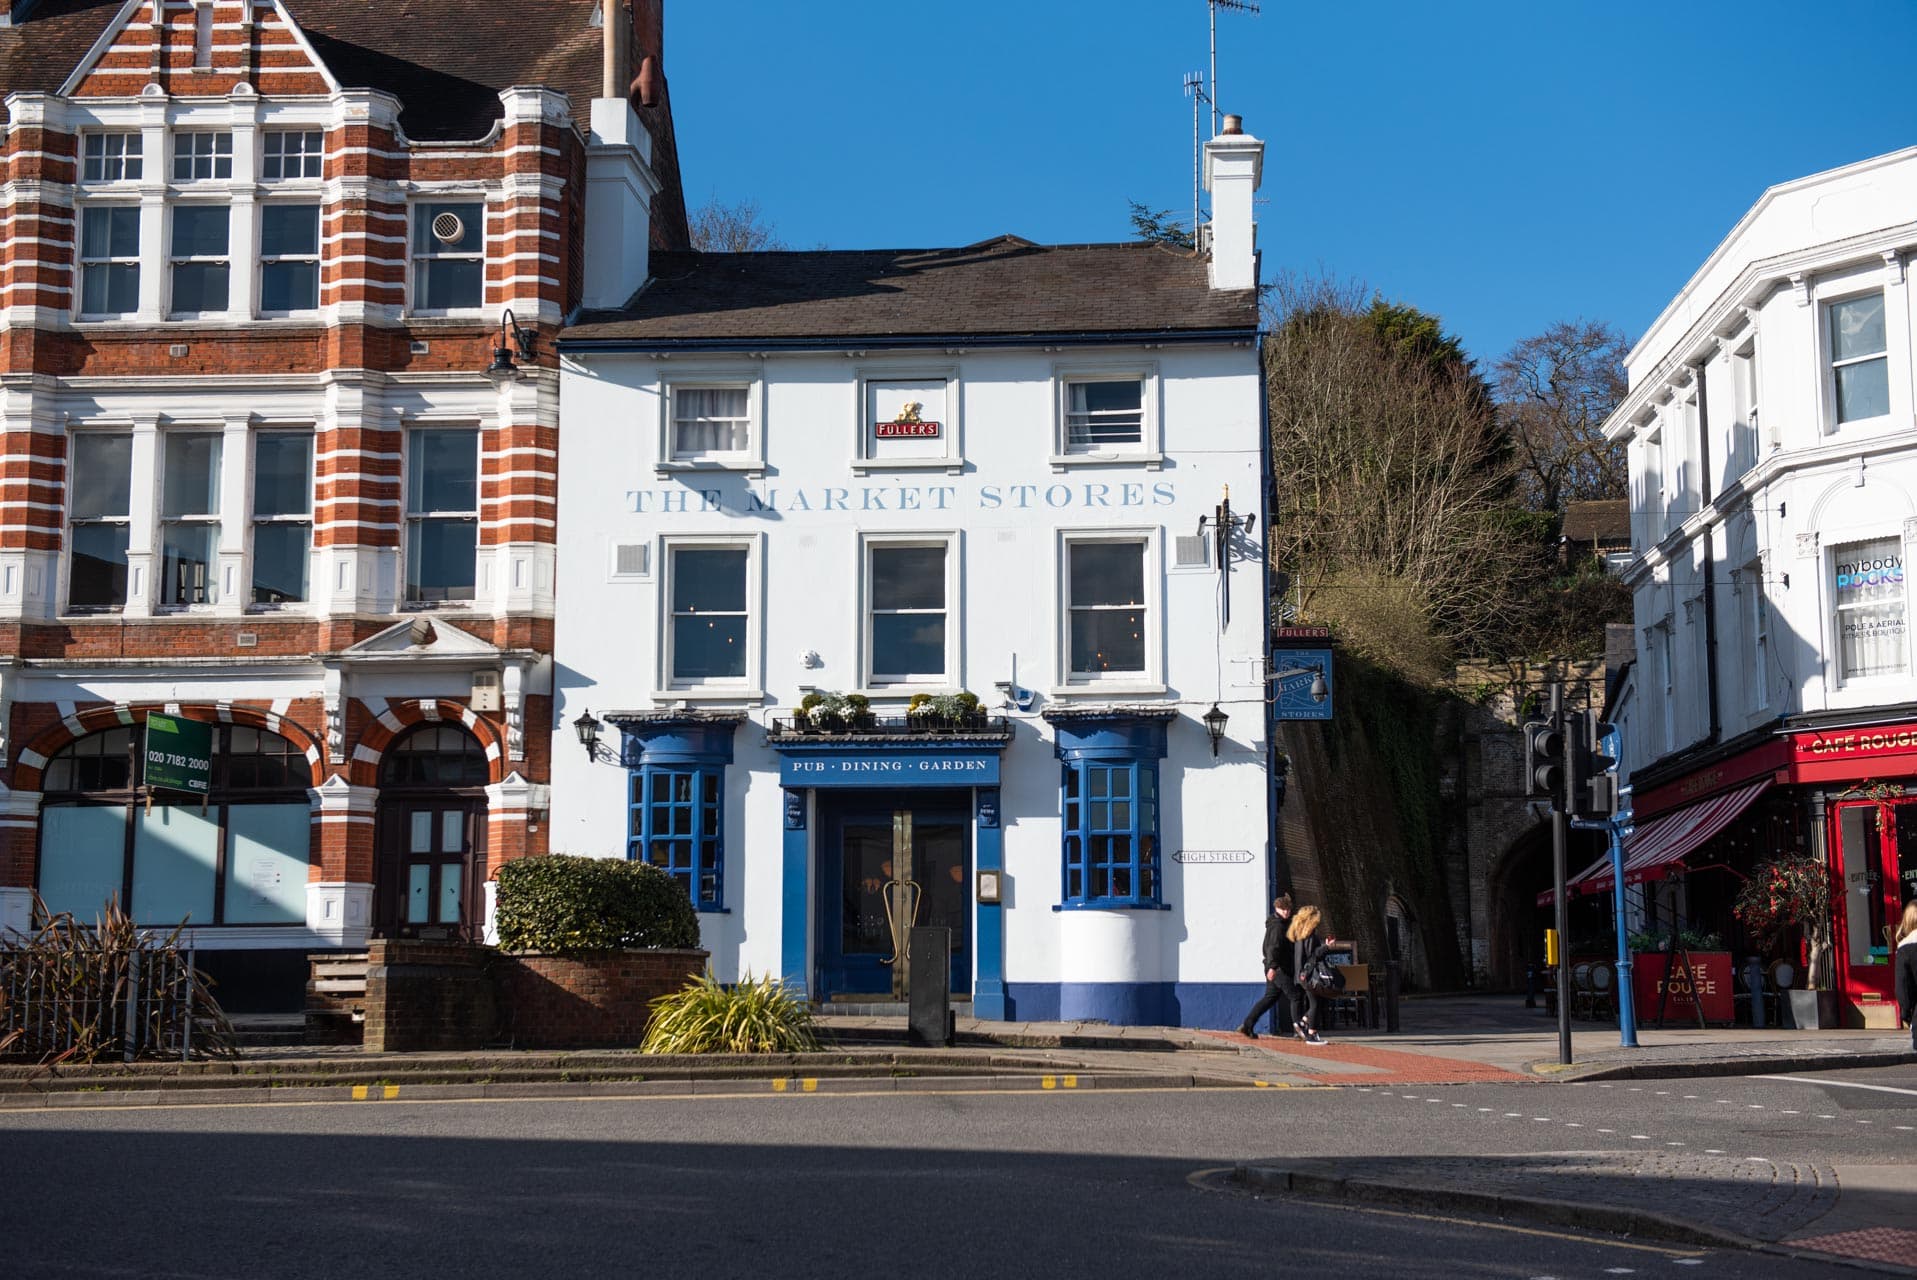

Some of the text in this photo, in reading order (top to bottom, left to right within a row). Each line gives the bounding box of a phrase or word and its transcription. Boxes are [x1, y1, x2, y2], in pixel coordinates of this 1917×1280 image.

[879, 424, 935, 434] FULLER'S
[626, 482, 1177, 513] THE MARKET STORES
[1837, 556, 1903, 576] mybody
[1837, 568, 1904, 590] ROCKS
[1845, 623, 1867, 633] POLE
[1876, 618, 1906, 628] AERIAL
[1812, 734, 1856, 754] CAFÉ
[1860, 731, 1917, 750] ROUGE
[149, 751, 209, 771] 020 7182 2000
[793, 760, 986, 771] PUB DINING GARDEN
[188, 779, 208, 790] CBRE
[1179, 853, 1246, 861] HIGH STREET
